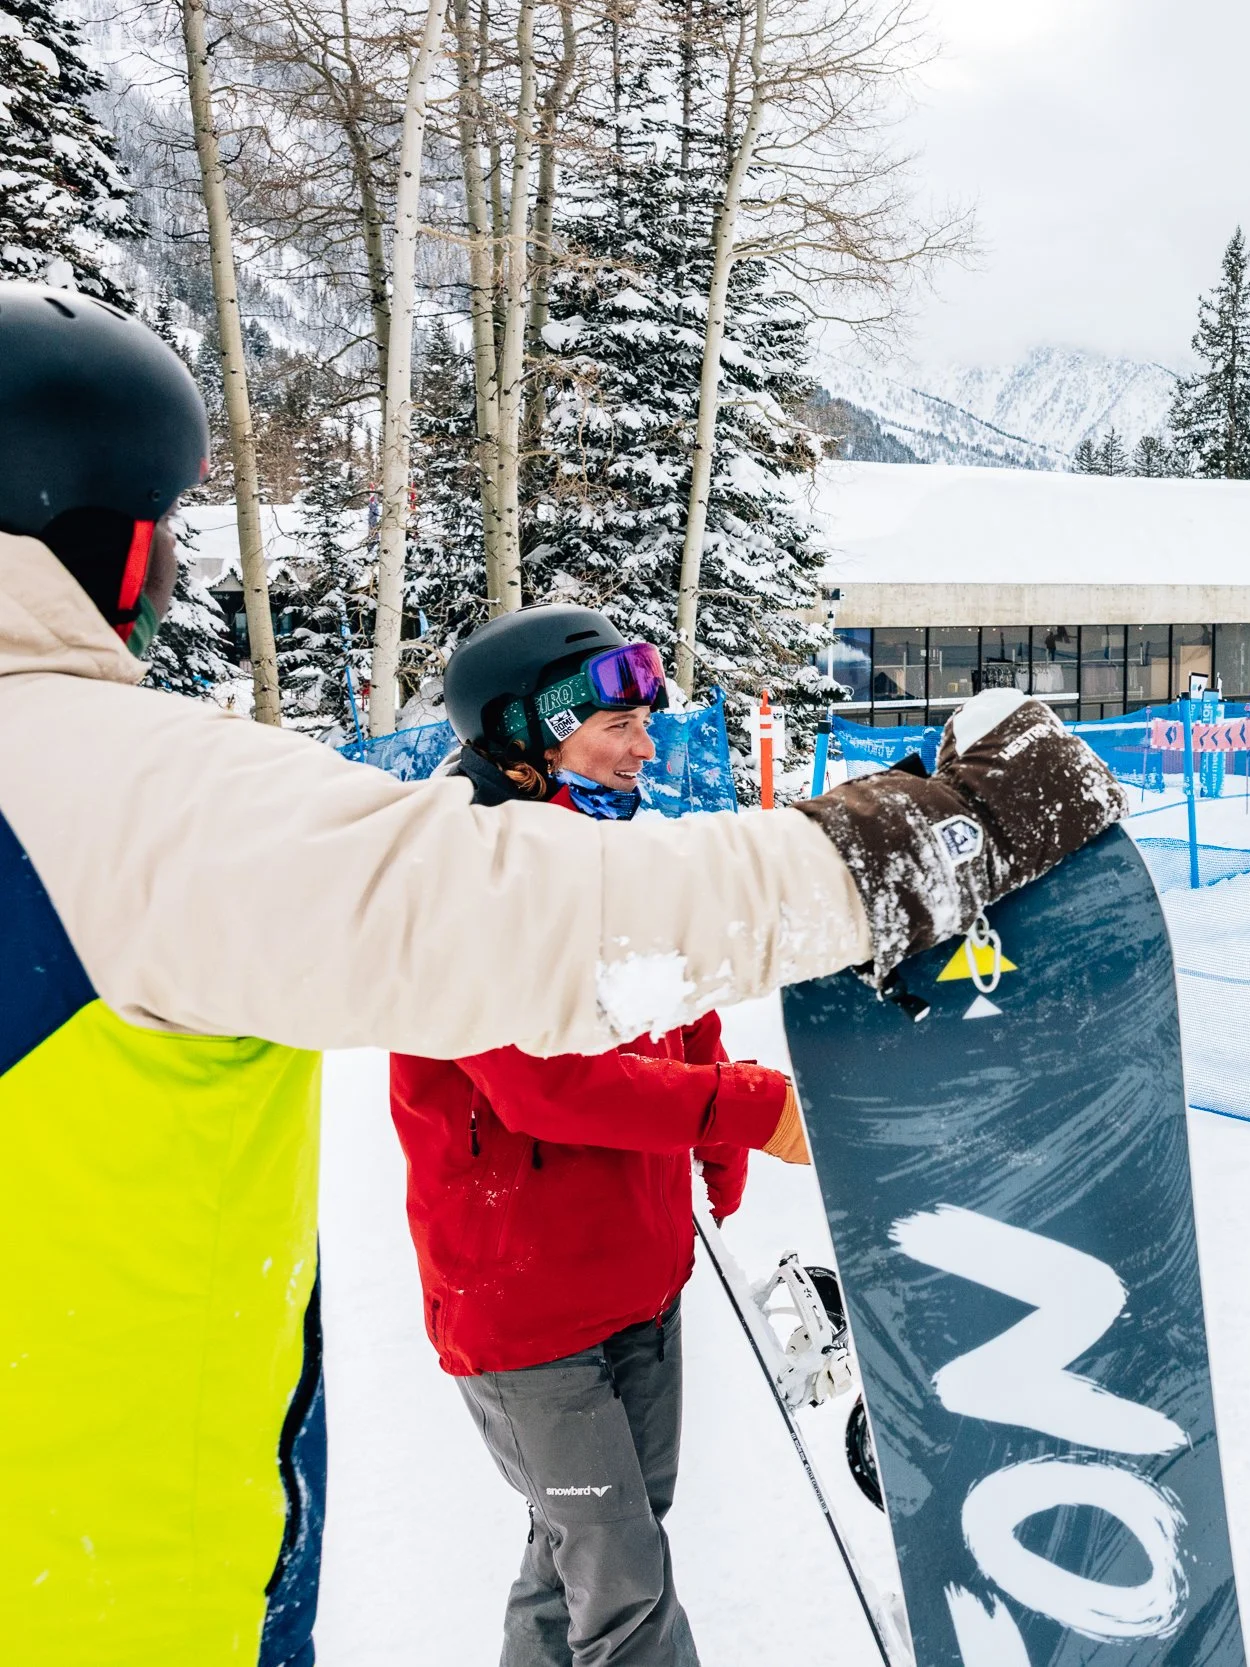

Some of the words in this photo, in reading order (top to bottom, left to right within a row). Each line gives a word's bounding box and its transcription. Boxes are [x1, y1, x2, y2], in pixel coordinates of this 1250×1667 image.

[535, 684, 573, 715] IRO
[553, 717, 575, 733] ROME
[546, 1486, 591, 1496] snowbird
